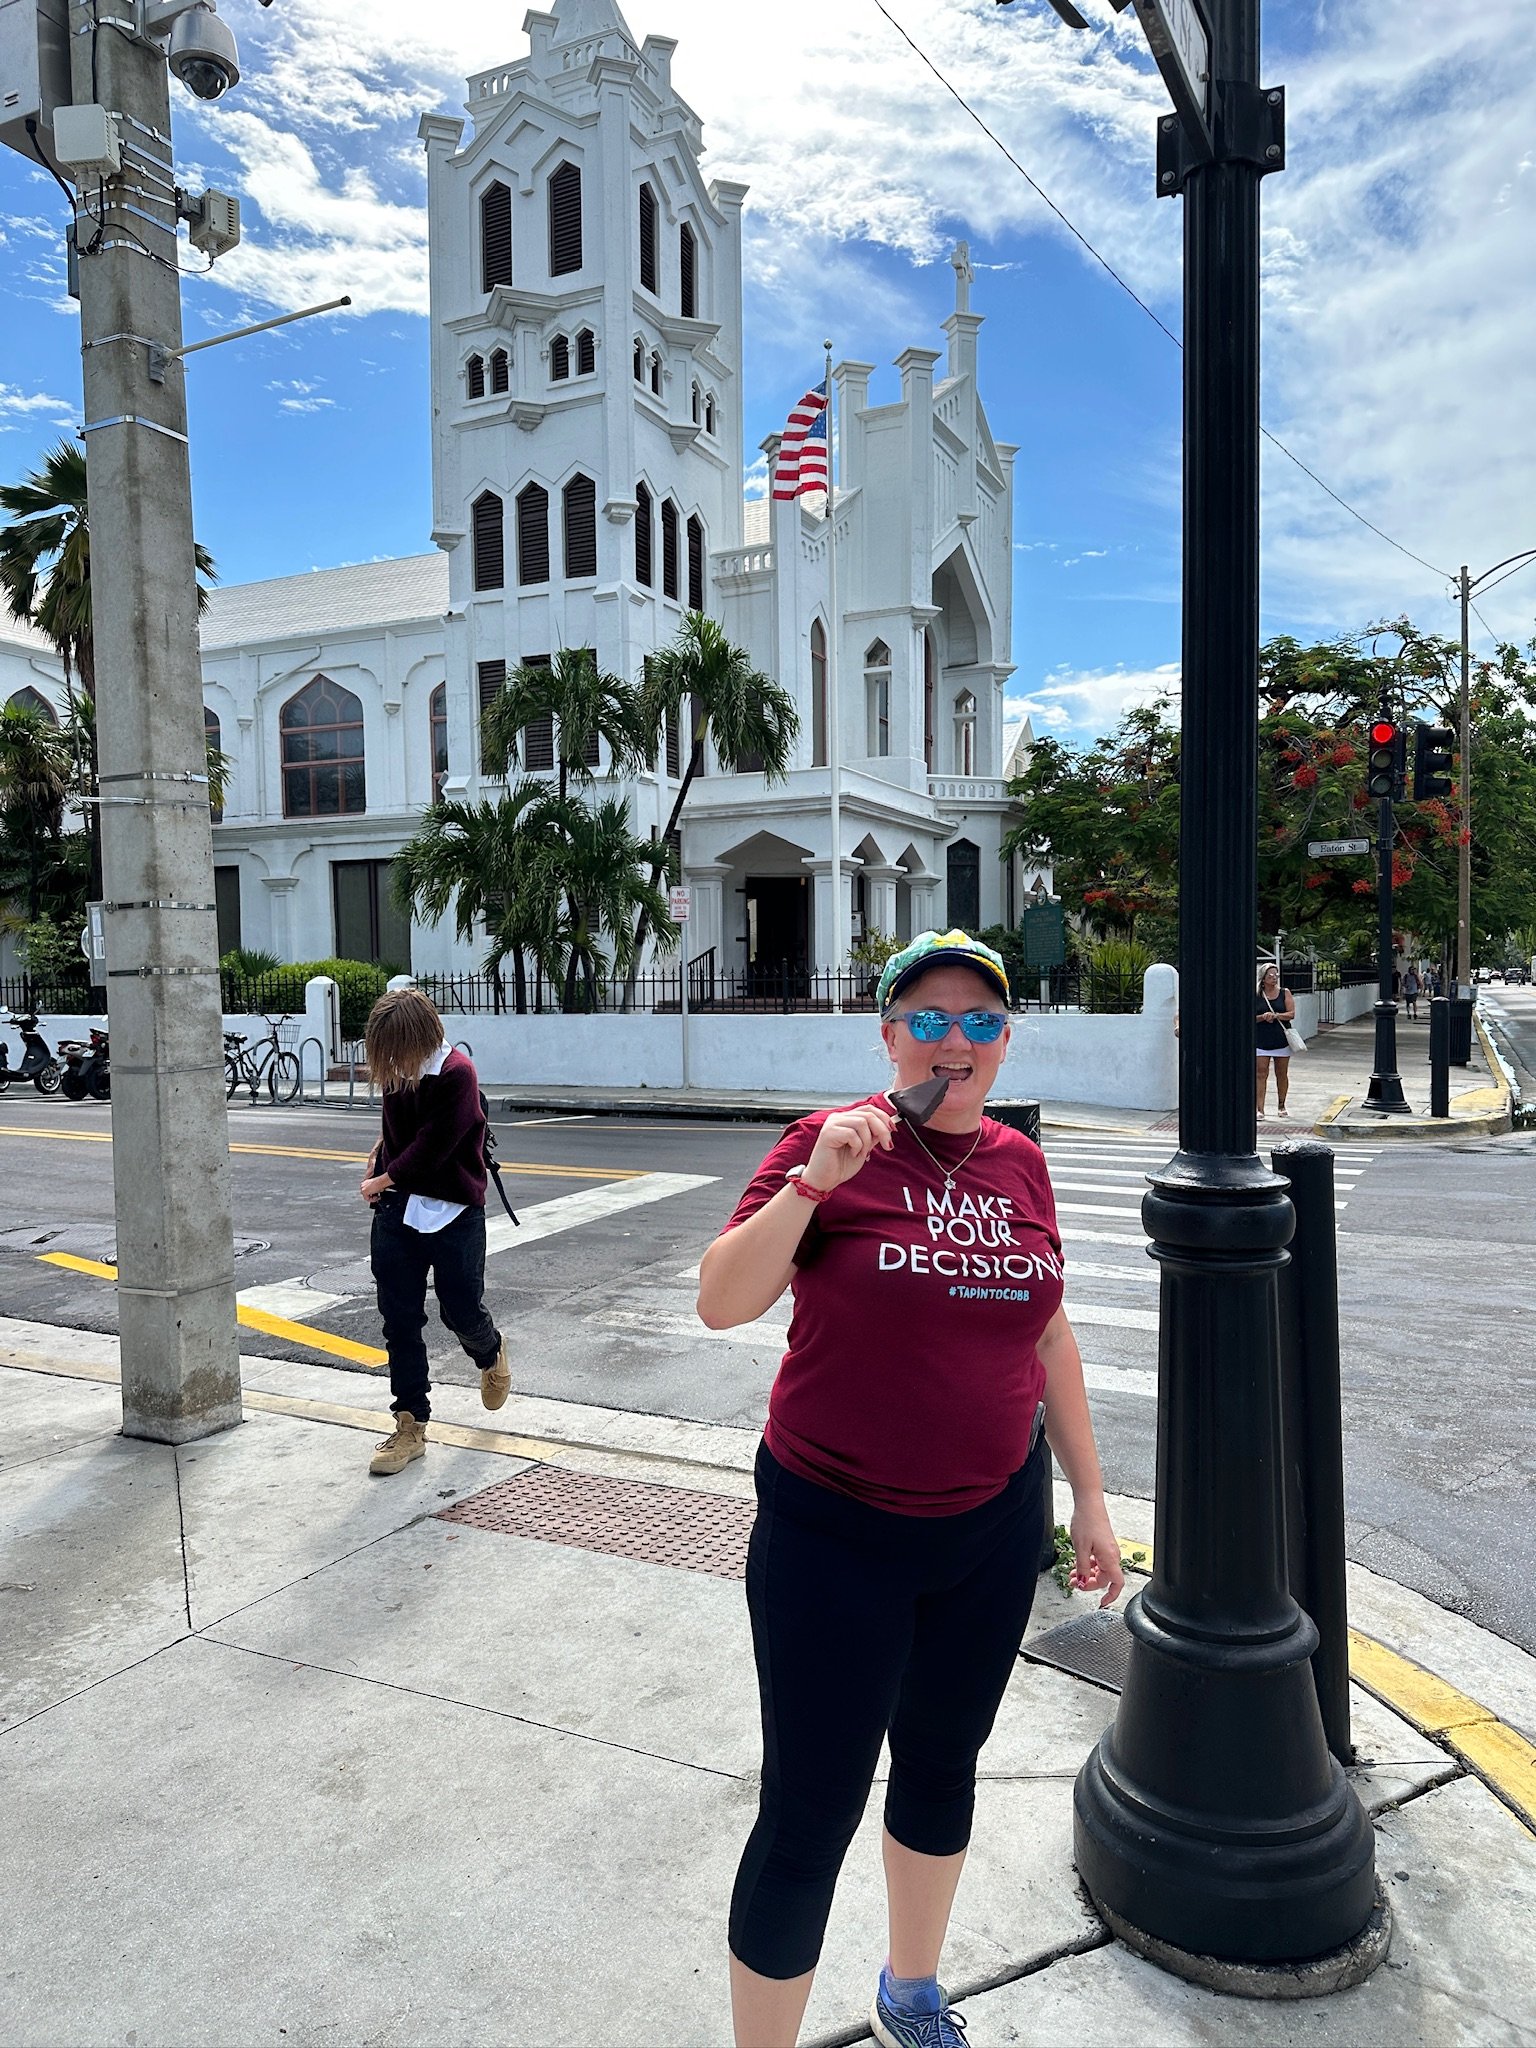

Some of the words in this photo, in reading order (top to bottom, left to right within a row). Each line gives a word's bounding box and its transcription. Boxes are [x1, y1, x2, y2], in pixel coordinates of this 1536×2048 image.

[1320, 844, 1345, 852] Eaton
[1348, 843, 1356, 851] St
[902, 1186, 914, 1213] I
[926, 1187, 1014, 1219] MAKE
[926, 1215, 1022, 1248] POUR
